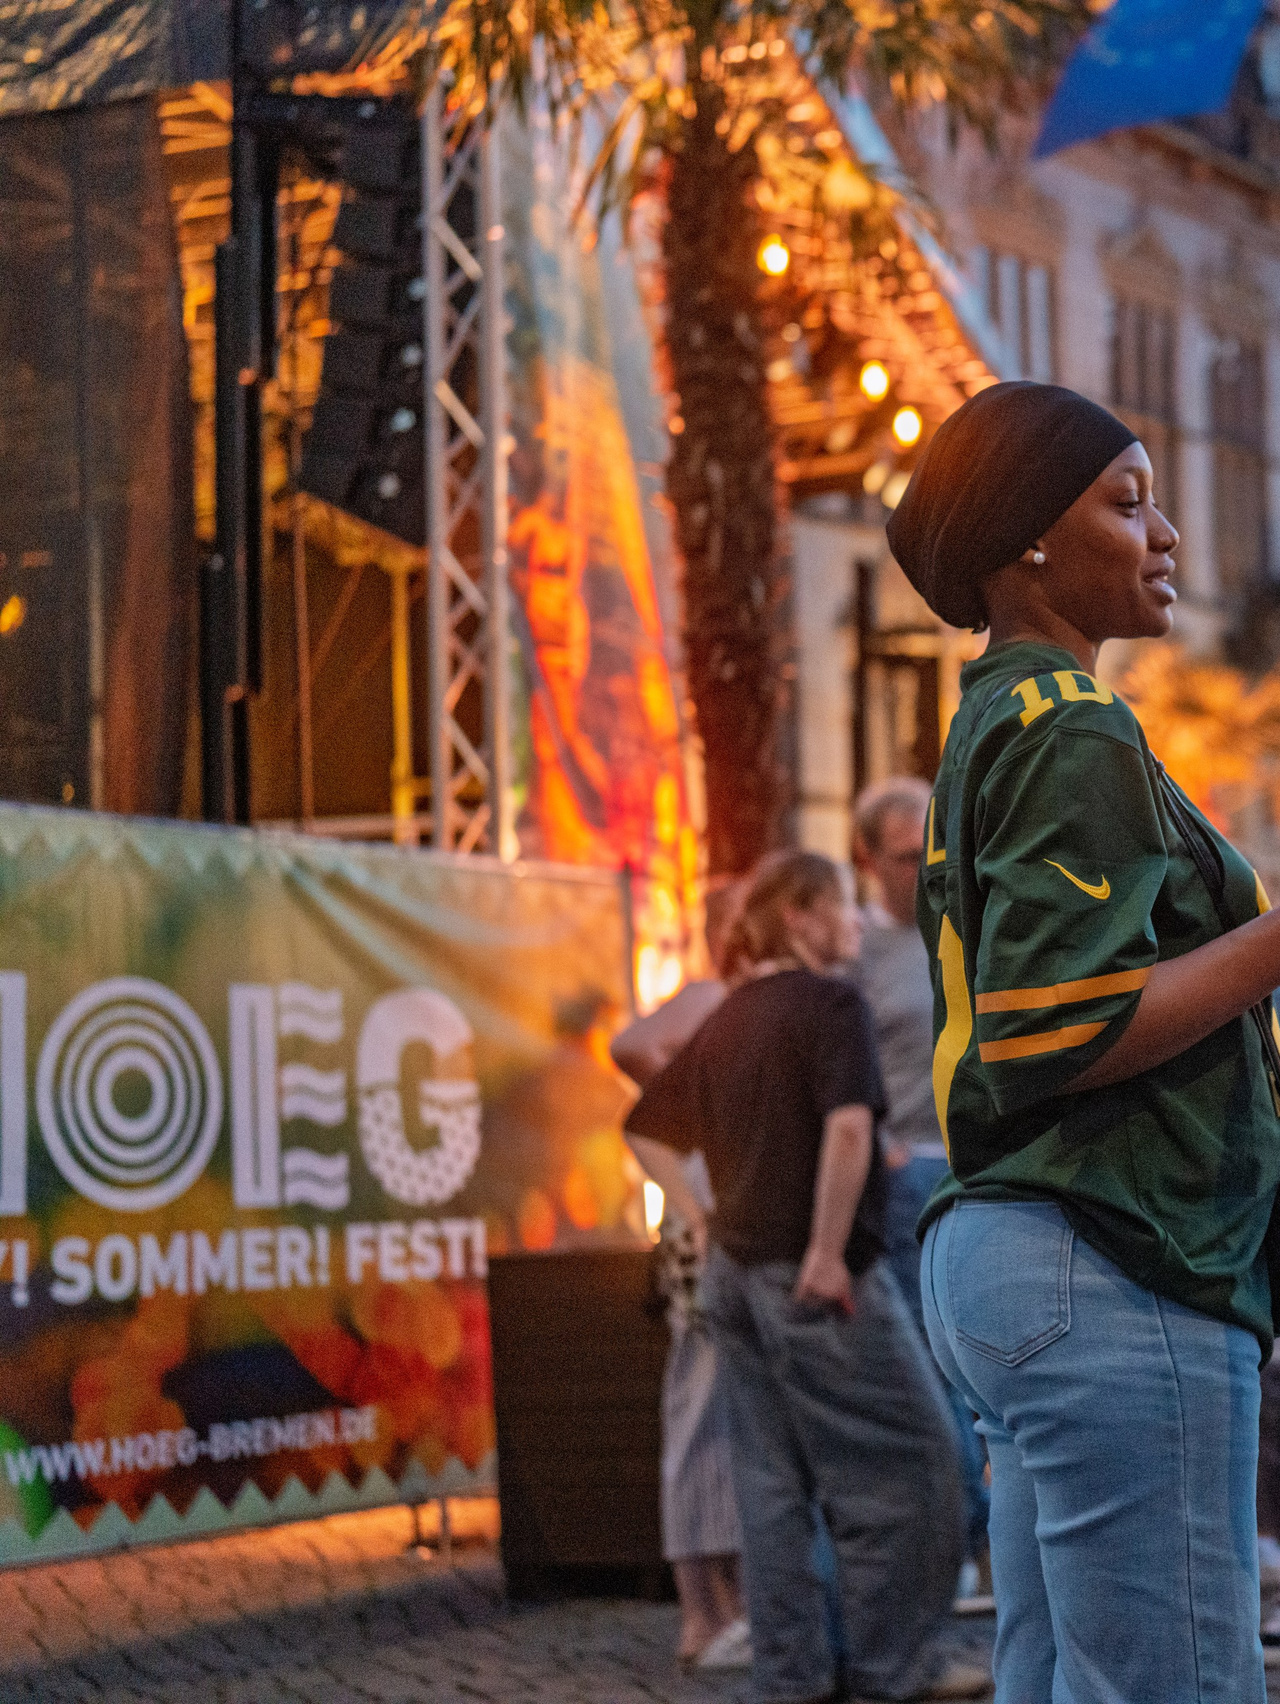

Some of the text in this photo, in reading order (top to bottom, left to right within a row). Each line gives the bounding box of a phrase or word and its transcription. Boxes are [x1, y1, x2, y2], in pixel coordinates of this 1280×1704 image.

[1011, 671, 1113, 727] 10
[51, 1225, 331, 1305] SOMMER!
[3, 1404, 379, 1485] WWW.HOEG-BREMEN.DE
